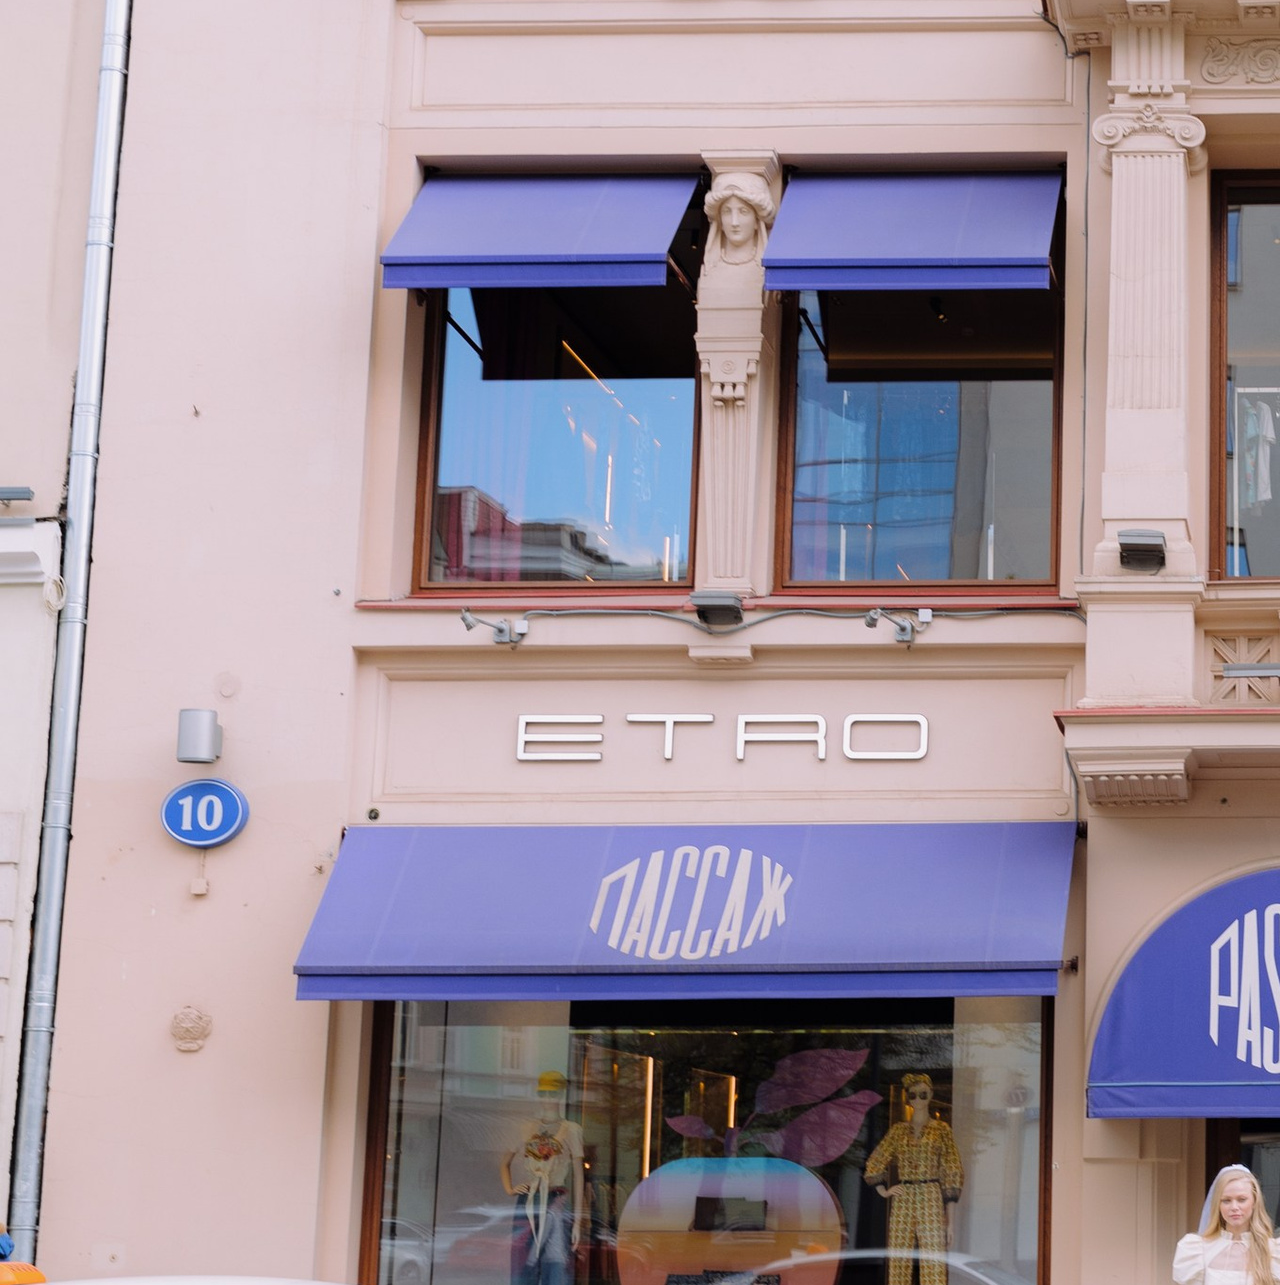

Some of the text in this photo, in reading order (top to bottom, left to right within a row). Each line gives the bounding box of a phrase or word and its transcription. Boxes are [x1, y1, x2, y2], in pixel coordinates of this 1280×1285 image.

[516, 713, 930, 761] ETRO
[177, 794, 223, 832] 10
[588, 844, 794, 961] ПАССАЖ
